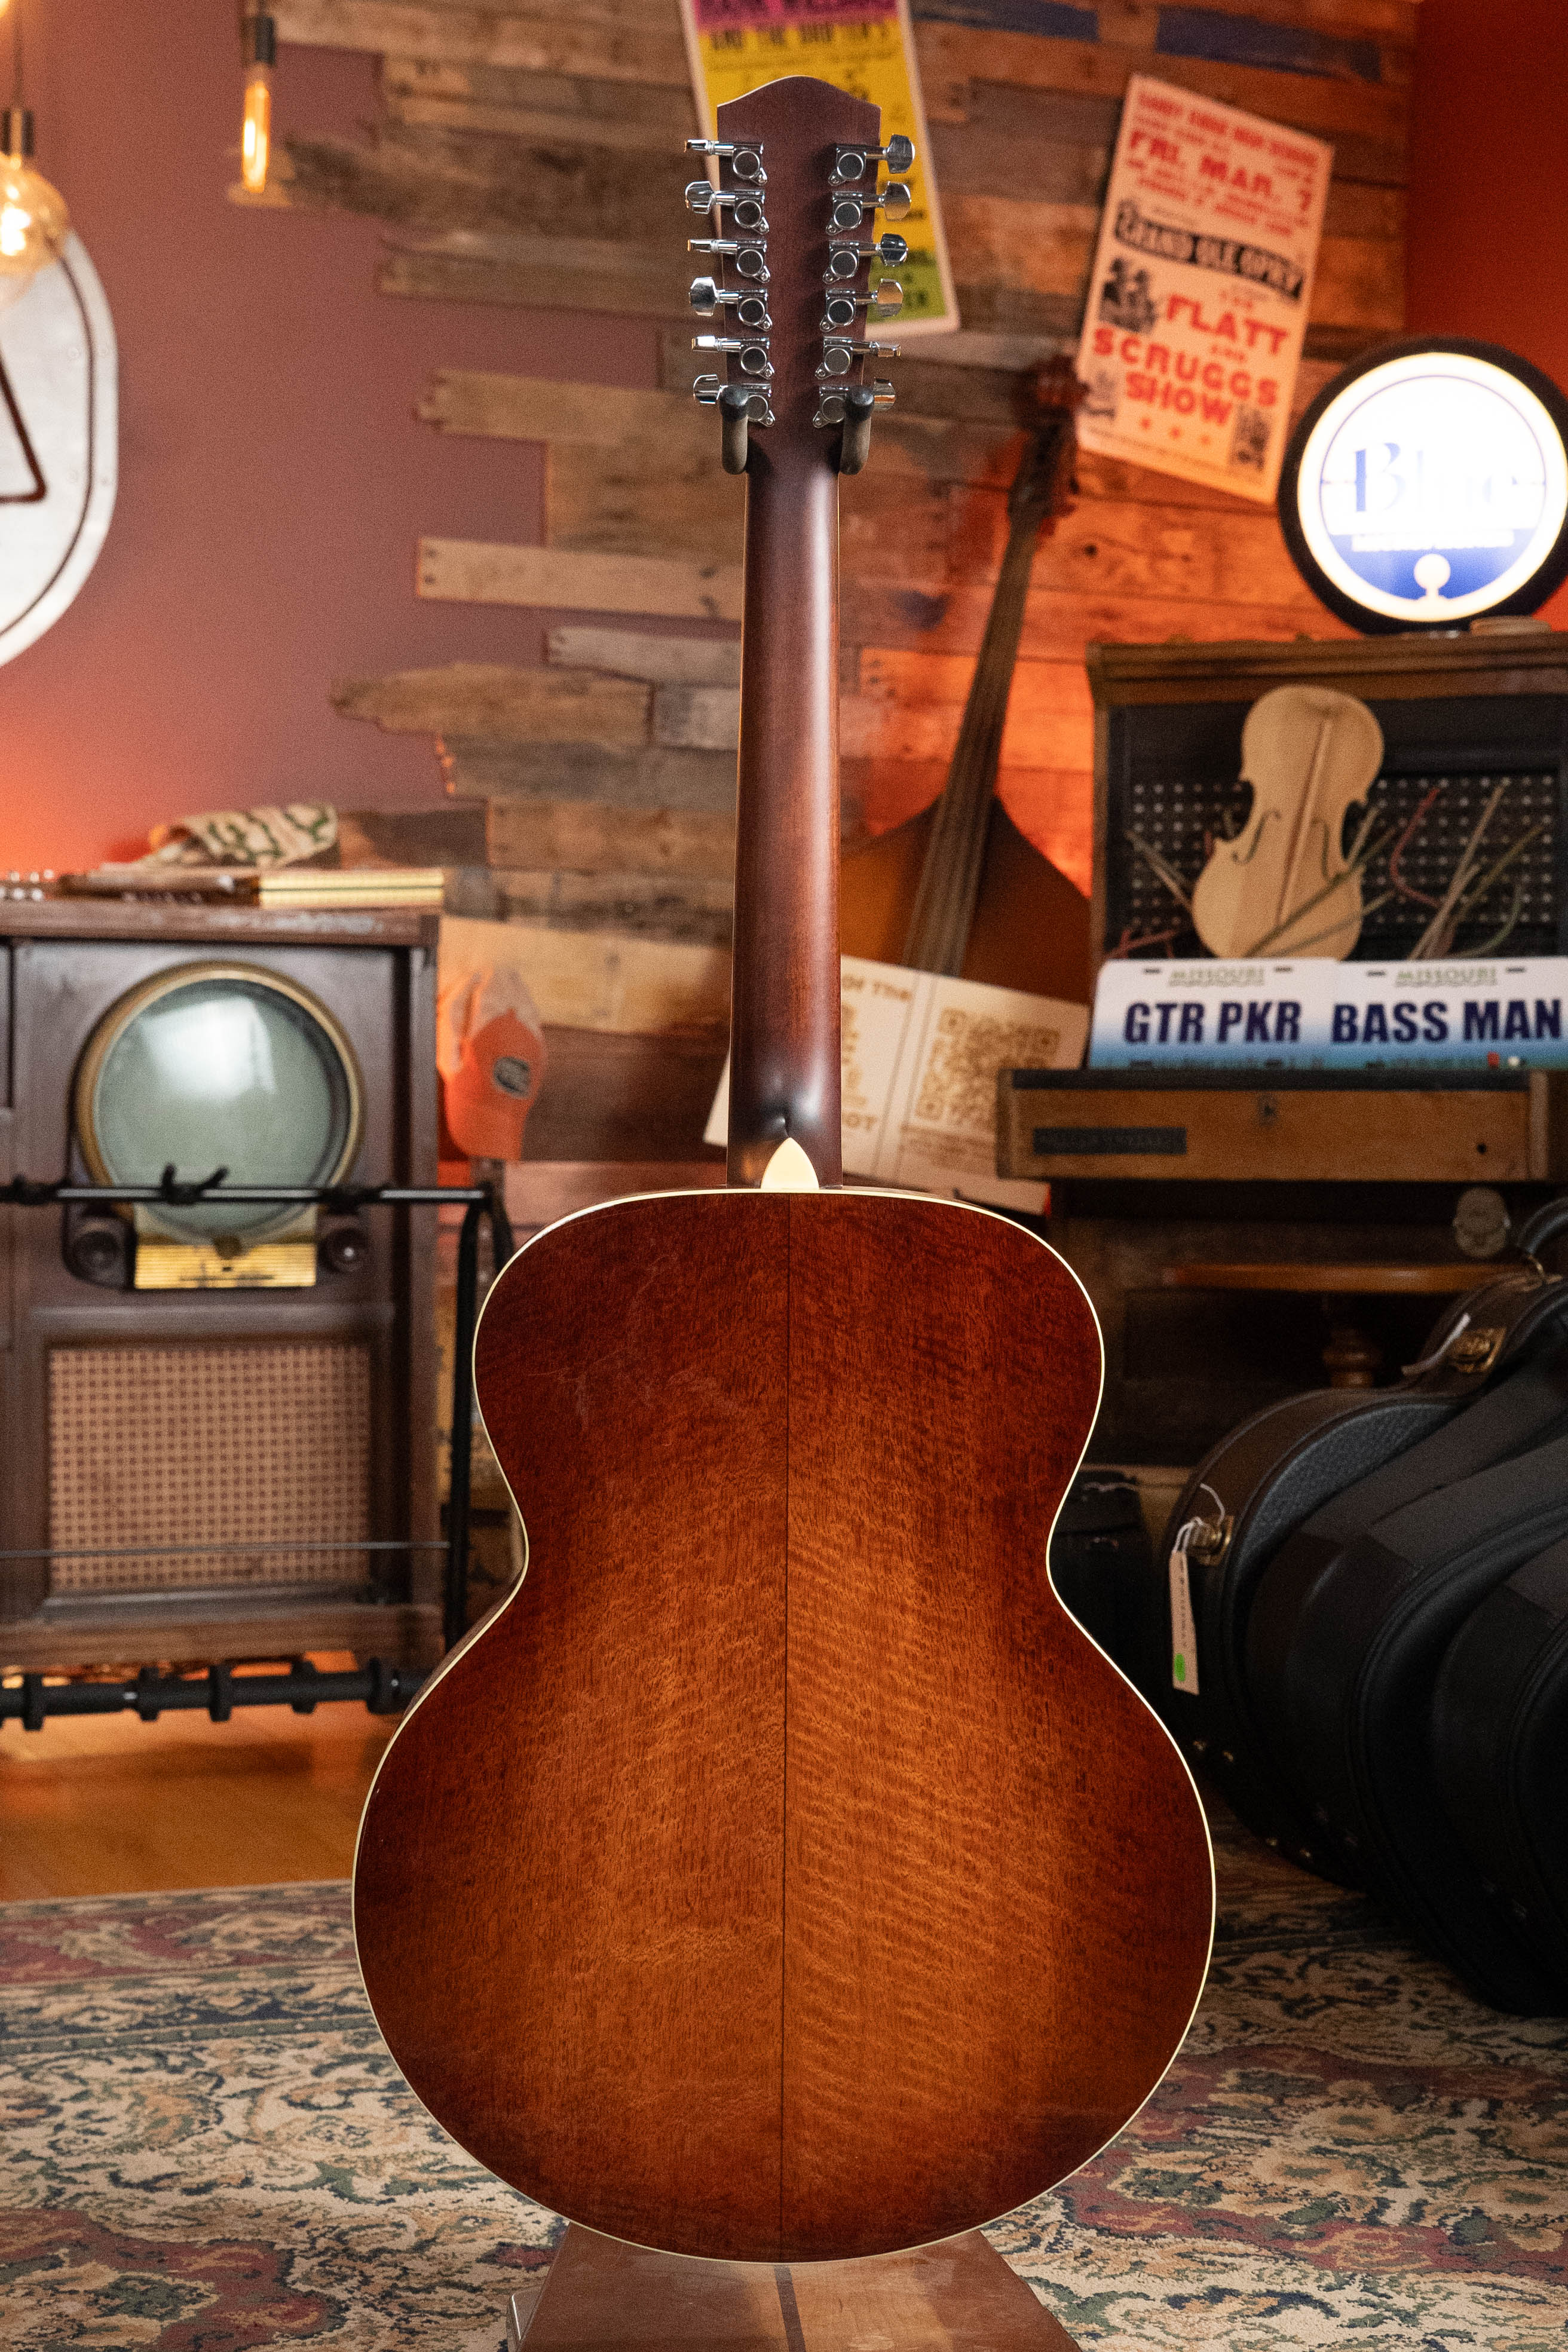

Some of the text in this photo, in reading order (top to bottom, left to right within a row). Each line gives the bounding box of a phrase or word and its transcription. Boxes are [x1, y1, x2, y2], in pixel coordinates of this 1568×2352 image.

[1166, 293, 1288, 357] FLATT
[1093, 326, 1279, 409] SCRUGGS
[1123, 370, 1233, 428] SHOW
[1124, 1001, 1301, 1043] GTR PKR
[1332, 999, 1563, 1043] BASS MAN
